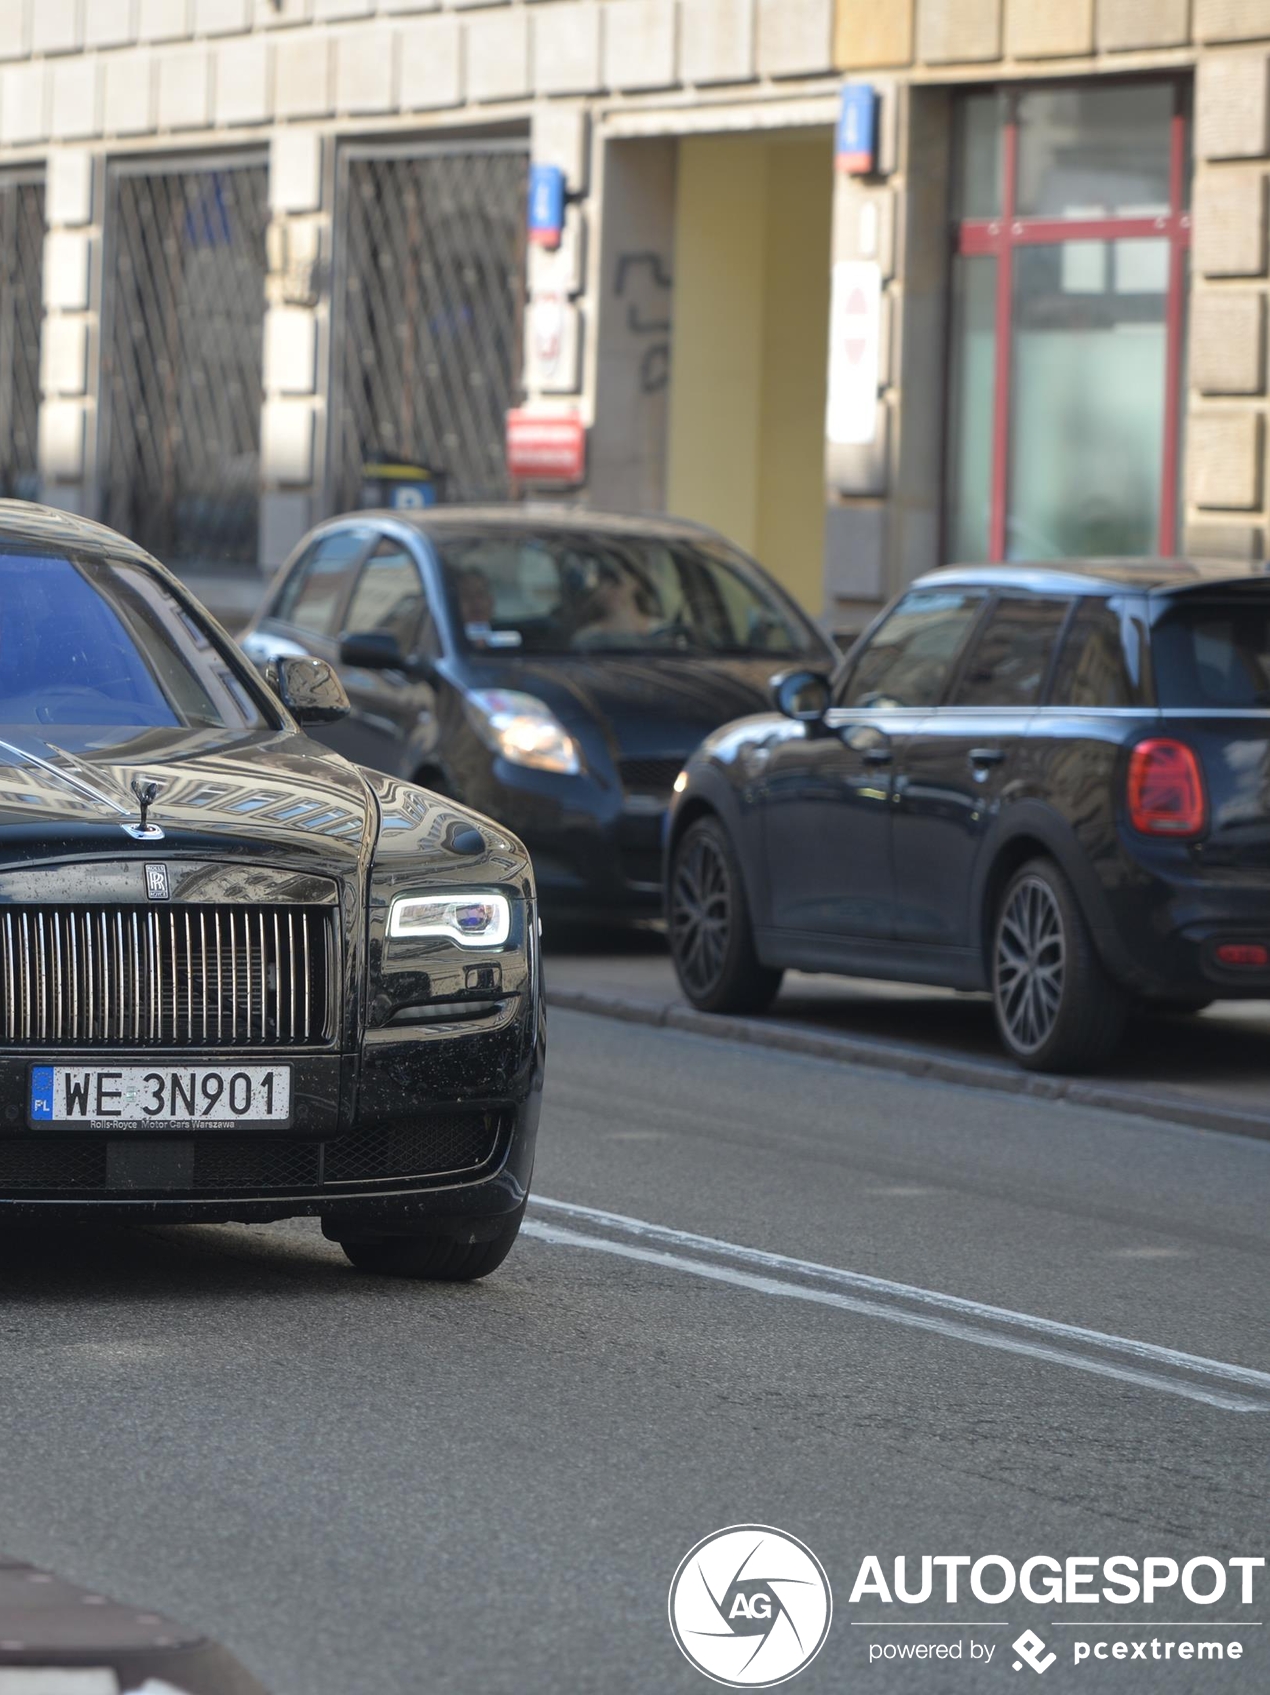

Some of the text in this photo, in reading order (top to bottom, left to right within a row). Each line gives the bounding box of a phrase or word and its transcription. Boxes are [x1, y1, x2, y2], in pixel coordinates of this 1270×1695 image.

[149, 872, 165, 890] RR
[65, 1072, 274, 1116] WE 3N901
[34, 1100, 50, 1112] PL
[90, 1120, 235, 1130] Rolls-Royce Motor Cars Warszawa
